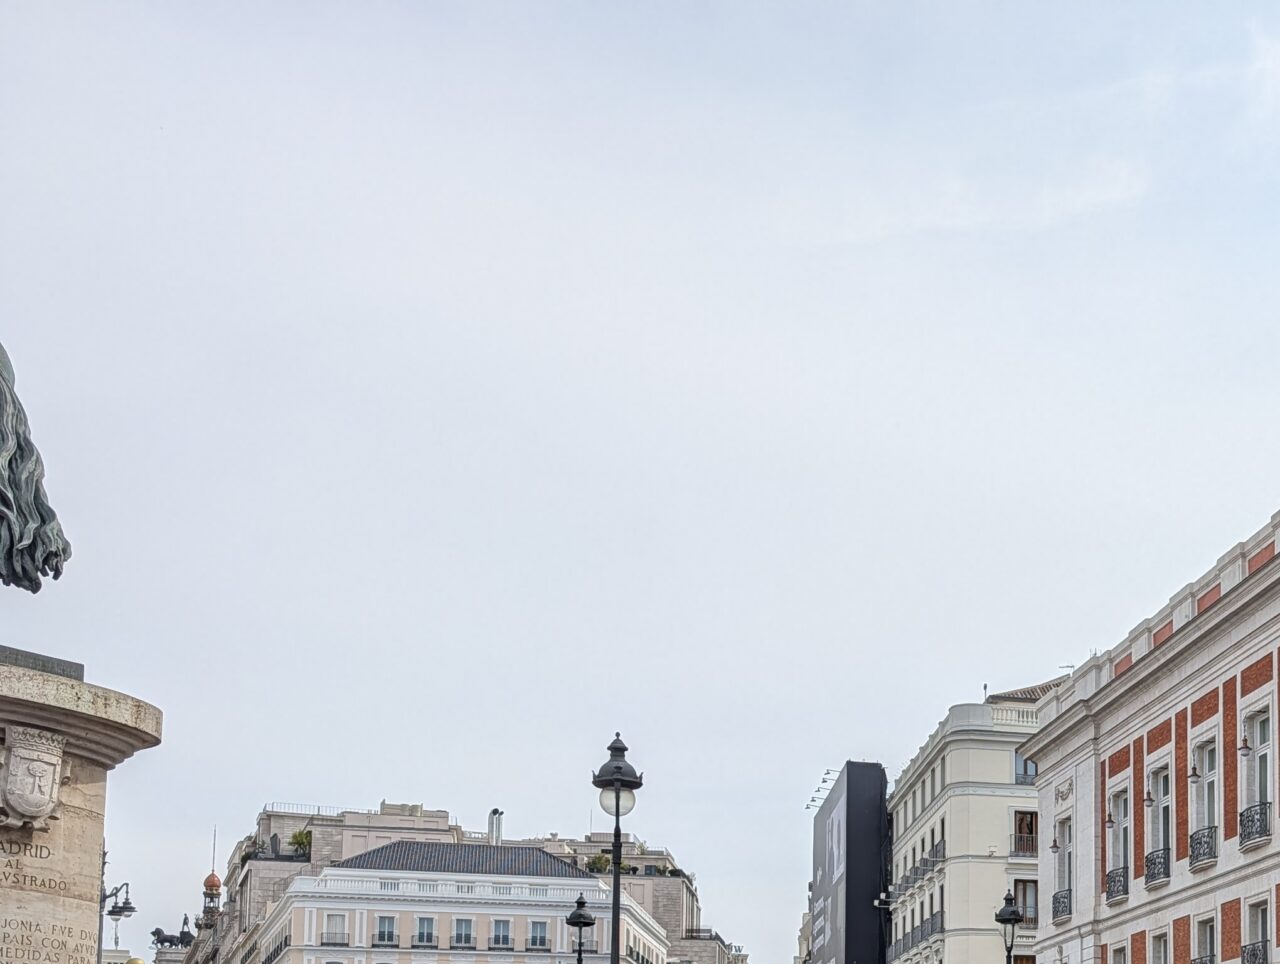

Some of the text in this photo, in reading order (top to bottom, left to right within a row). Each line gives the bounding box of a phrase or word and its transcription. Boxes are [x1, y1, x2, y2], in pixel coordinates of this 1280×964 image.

[4, 859, 23, 870] AL
[51, 924, 73, 938] FVE
[2, 932, 32, 946] PAIS
[41, 937, 67, 951] CON
